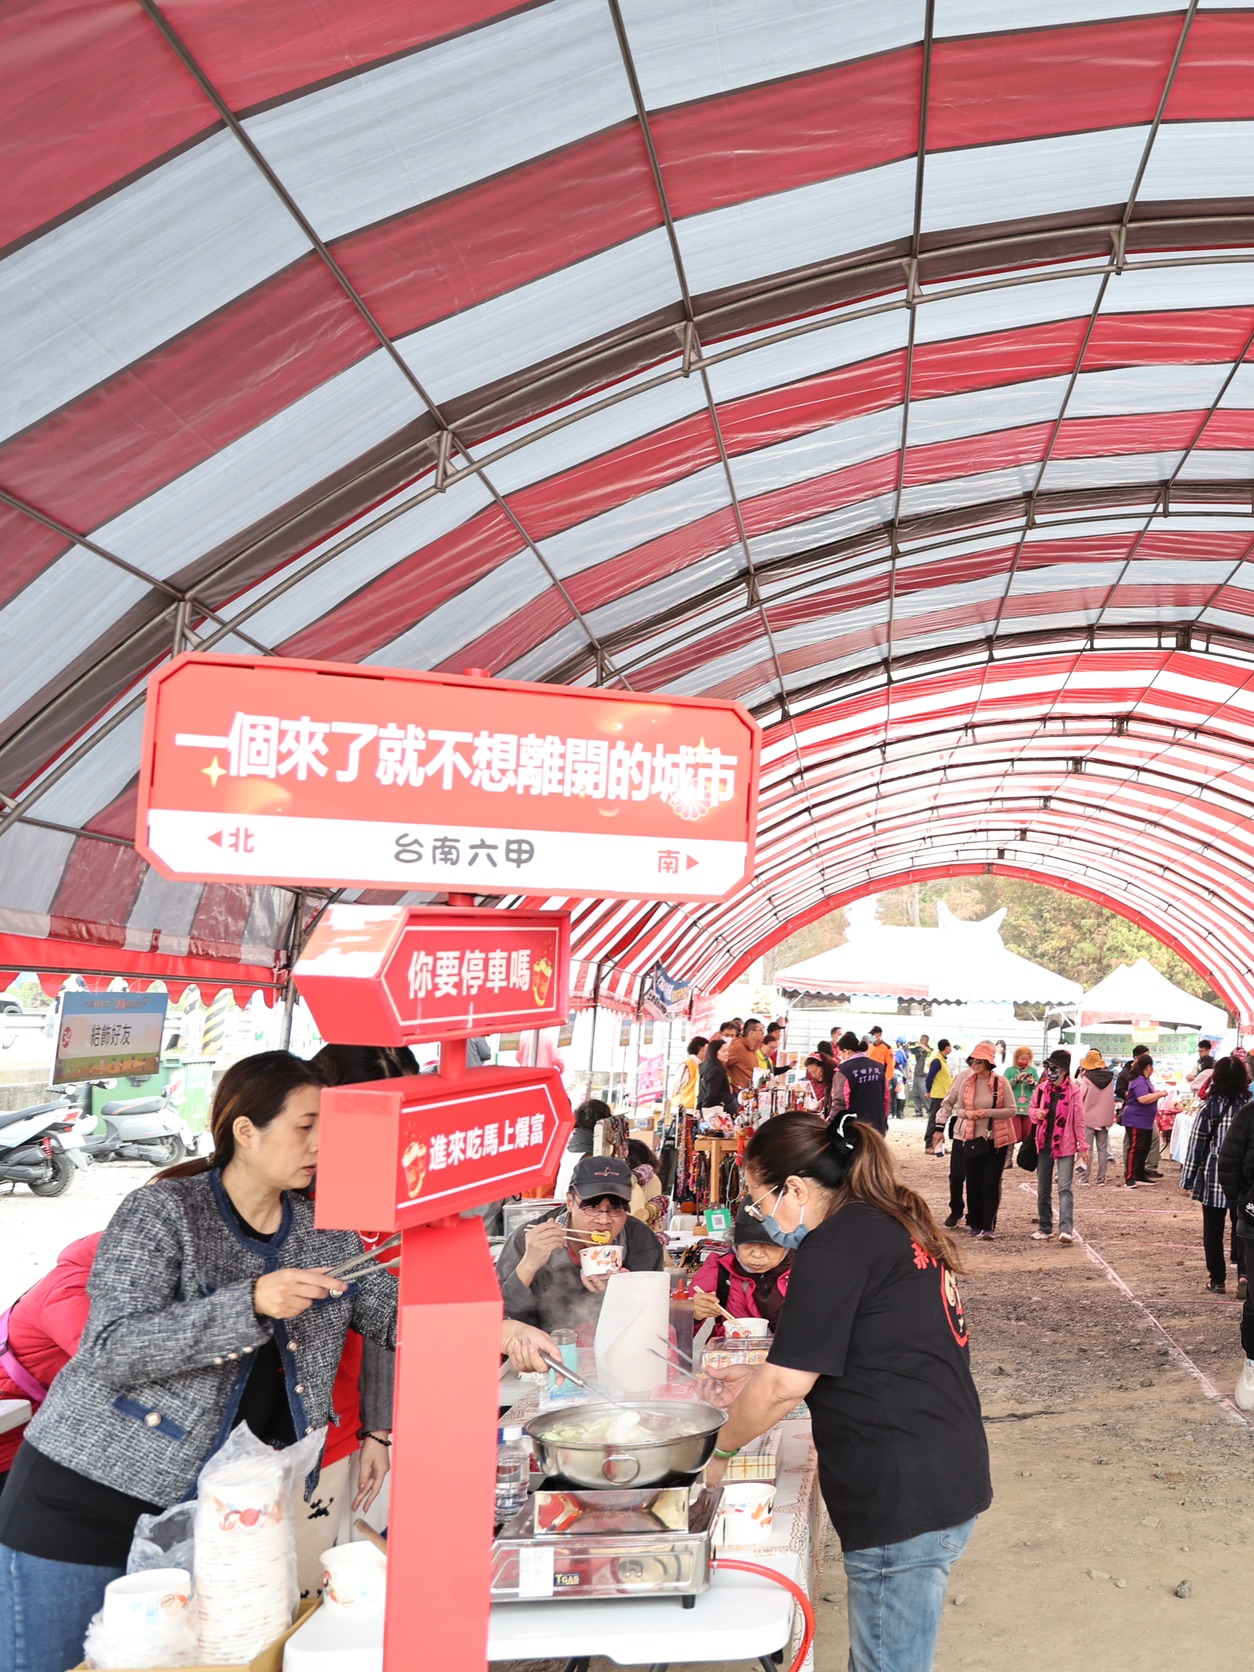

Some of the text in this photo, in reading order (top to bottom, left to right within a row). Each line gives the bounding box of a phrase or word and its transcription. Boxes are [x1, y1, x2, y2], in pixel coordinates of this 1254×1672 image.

[175, 712, 738, 807] 一個來了就不想離開的城市
[228, 826, 255, 853] 北
[394, 833, 535, 868] 台南六甲
[657, 850, 680, 874] 南
[408, 949, 531, 999] 你要停車嗎
[90, 1024, 132, 1047] 結飾好友
[858, 1074, 879, 1083] STAFF
[428, 1113, 545, 1171] 進來吃馬上爆富
